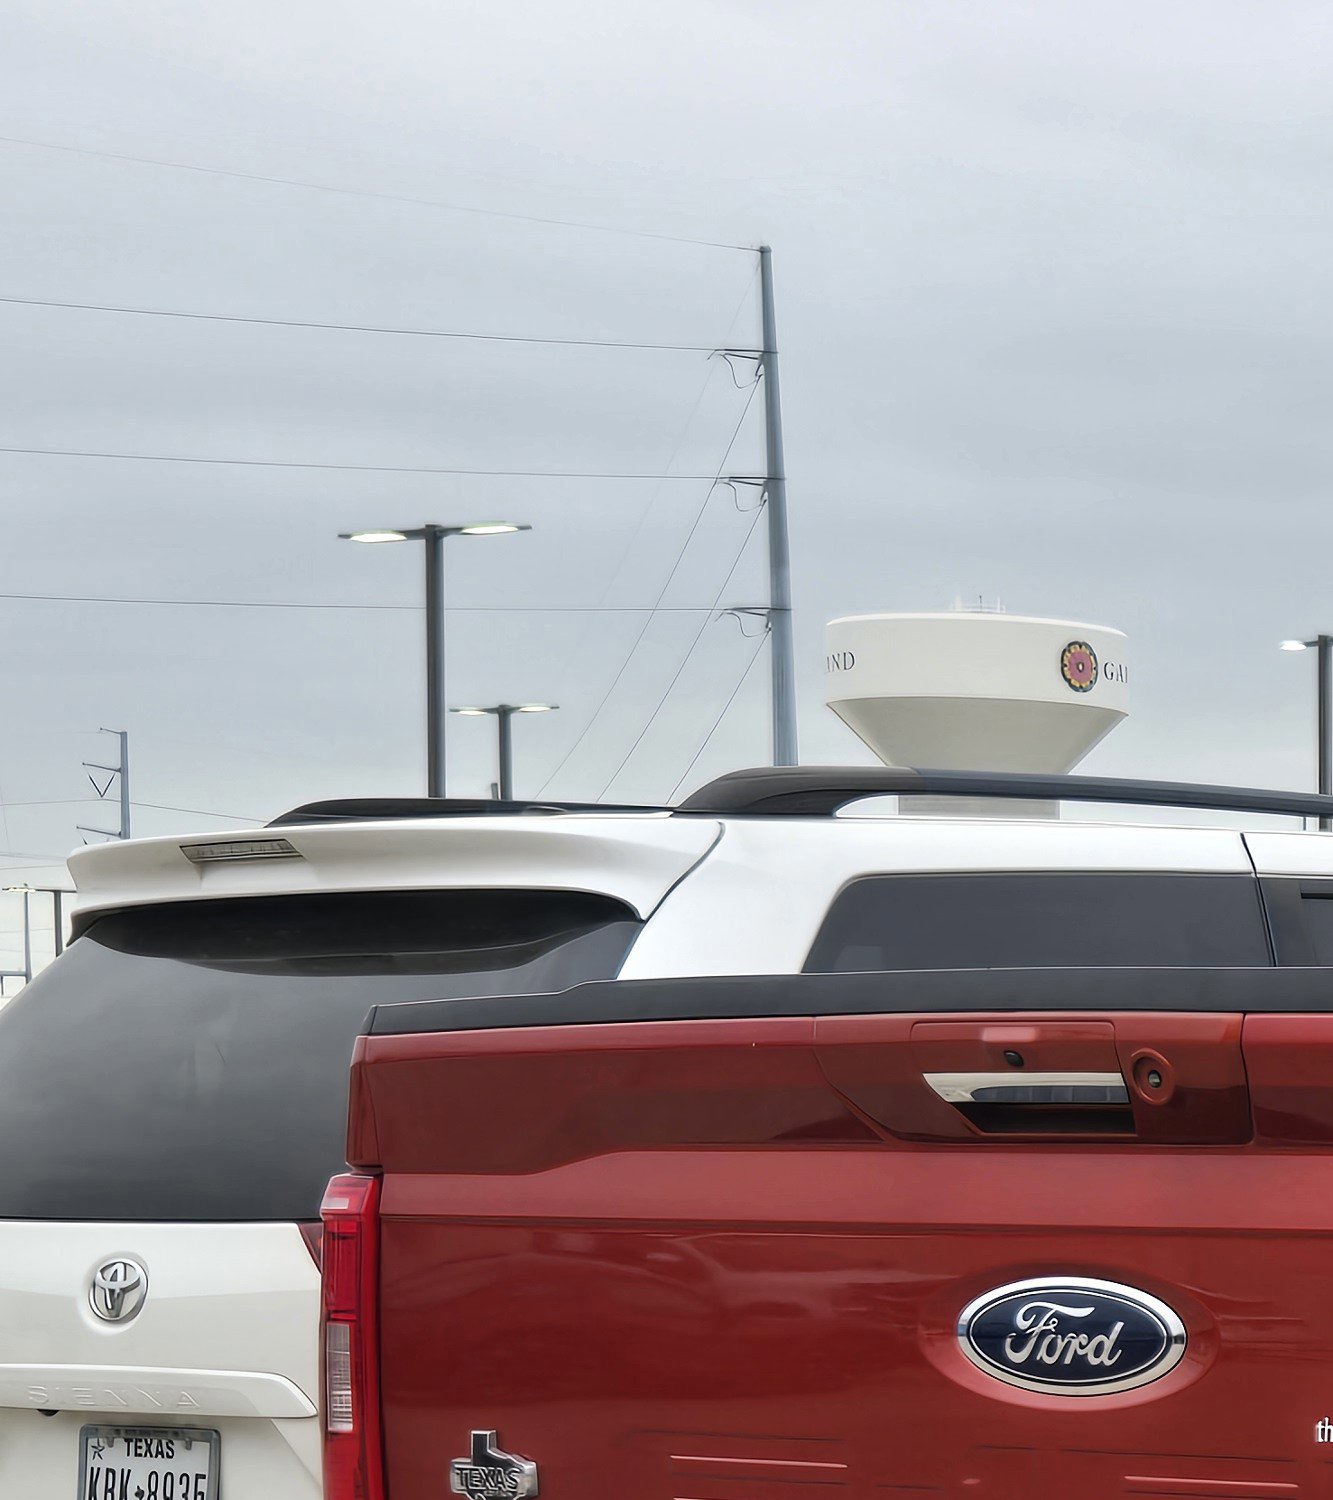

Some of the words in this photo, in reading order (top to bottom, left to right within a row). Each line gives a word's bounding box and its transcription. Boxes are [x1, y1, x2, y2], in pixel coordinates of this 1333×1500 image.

[1004, 1301, 1125, 1366] Ford
[123, 1438, 175, 1459] TEXAS
[455, 1466, 521, 1492] TEXAS
